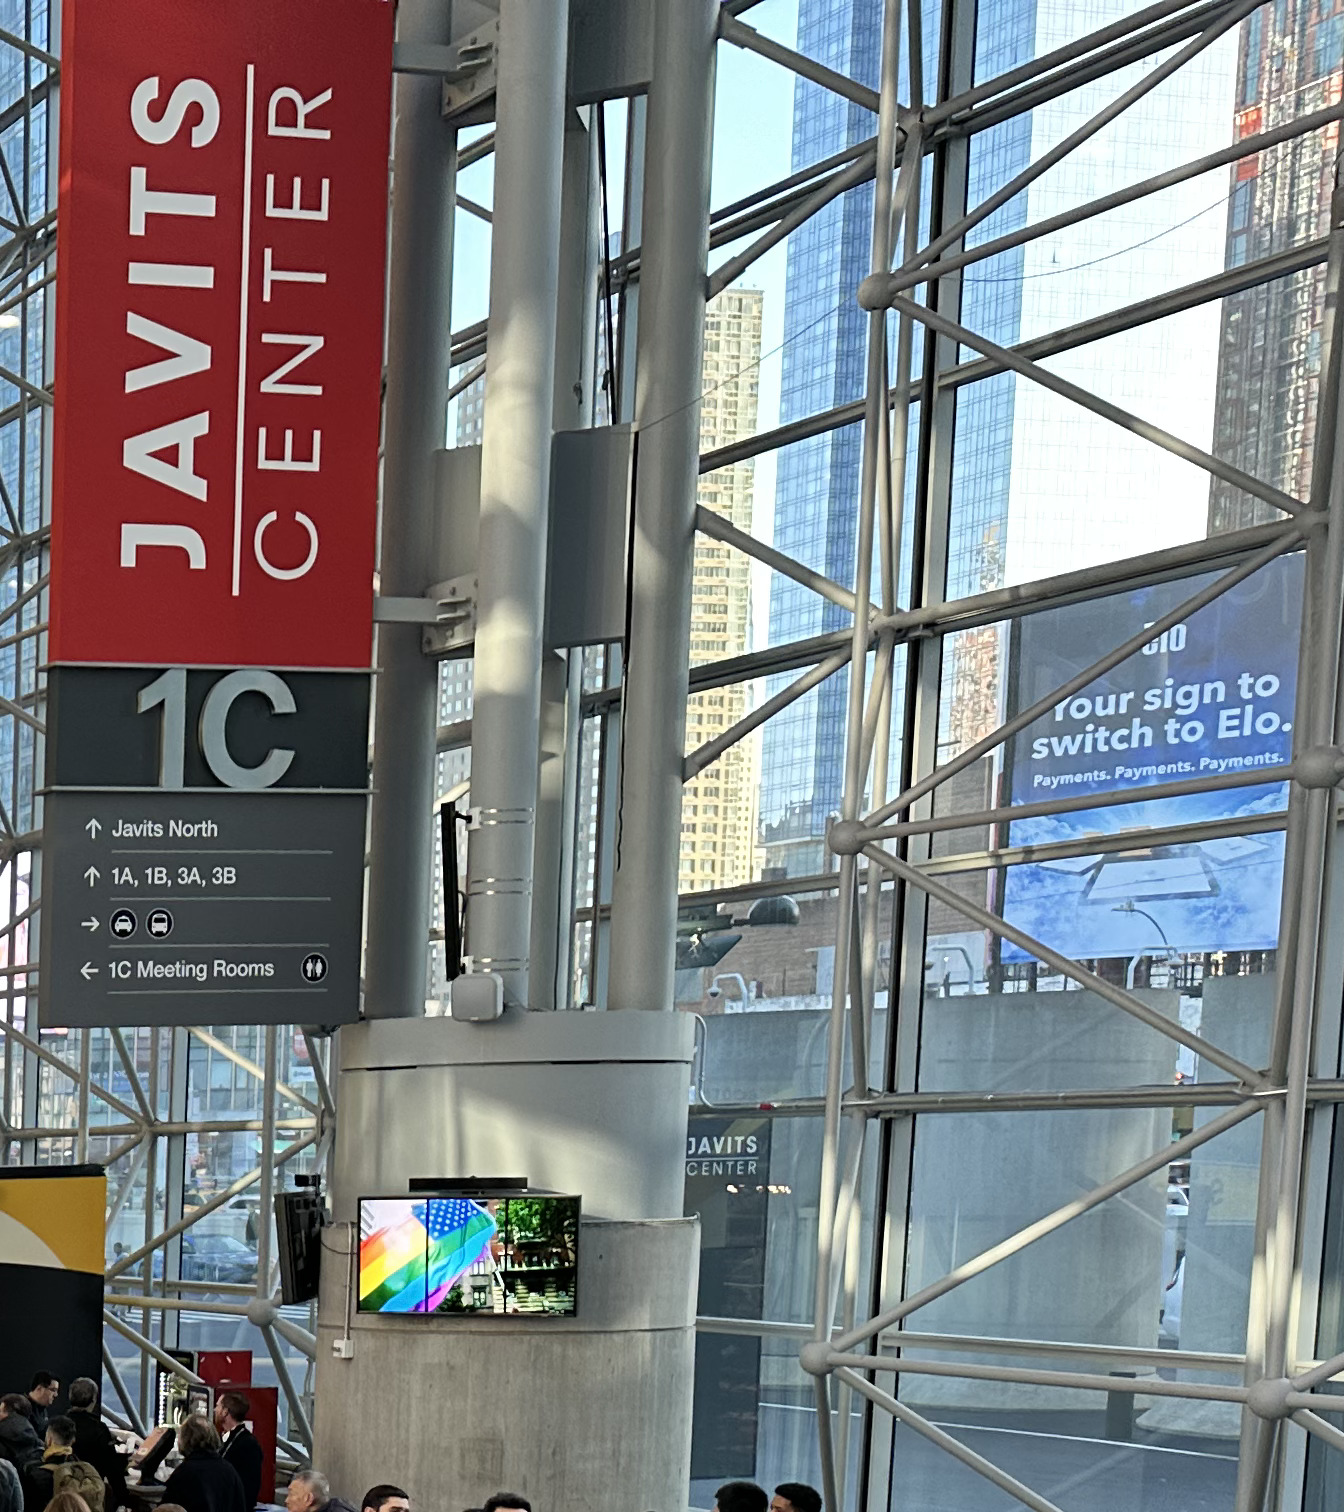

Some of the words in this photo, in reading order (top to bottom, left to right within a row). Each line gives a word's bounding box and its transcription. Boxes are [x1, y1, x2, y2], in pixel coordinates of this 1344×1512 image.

[120, 76, 221, 570] JAVITS
[254, 86, 333, 581] CENTER
[1054, 690, 1135, 721] Your
[1143, 678, 1225, 715] sign
[1237, 672, 1280, 699] to
[137, 668, 297, 789] 1C
[1031, 717, 1153, 760] switch
[1164, 718, 1204, 744] to
[1217, 705, 1292, 739] Elo.
[1033, 770, 1111, 788] Payments.
[1115, 761, 1195, 780] Payments.
[1199, 751, 1284, 771] Payments.
[111, 819, 164, 838] Javits
[169, 819, 218, 838] North
[111, 868, 140, 887] 1A,
[145, 868, 173, 887] 1B,
[177, 868, 207, 887] 3A,
[212, 867, 237, 884] 3B
[108, 961, 132, 979] 1C
[137, 960, 208, 981] Meeting
[213, 960, 275, 978] Rooms
[687, 1136, 757, 1155] JAVITS
[686, 1160, 757, 1176] CENTER
